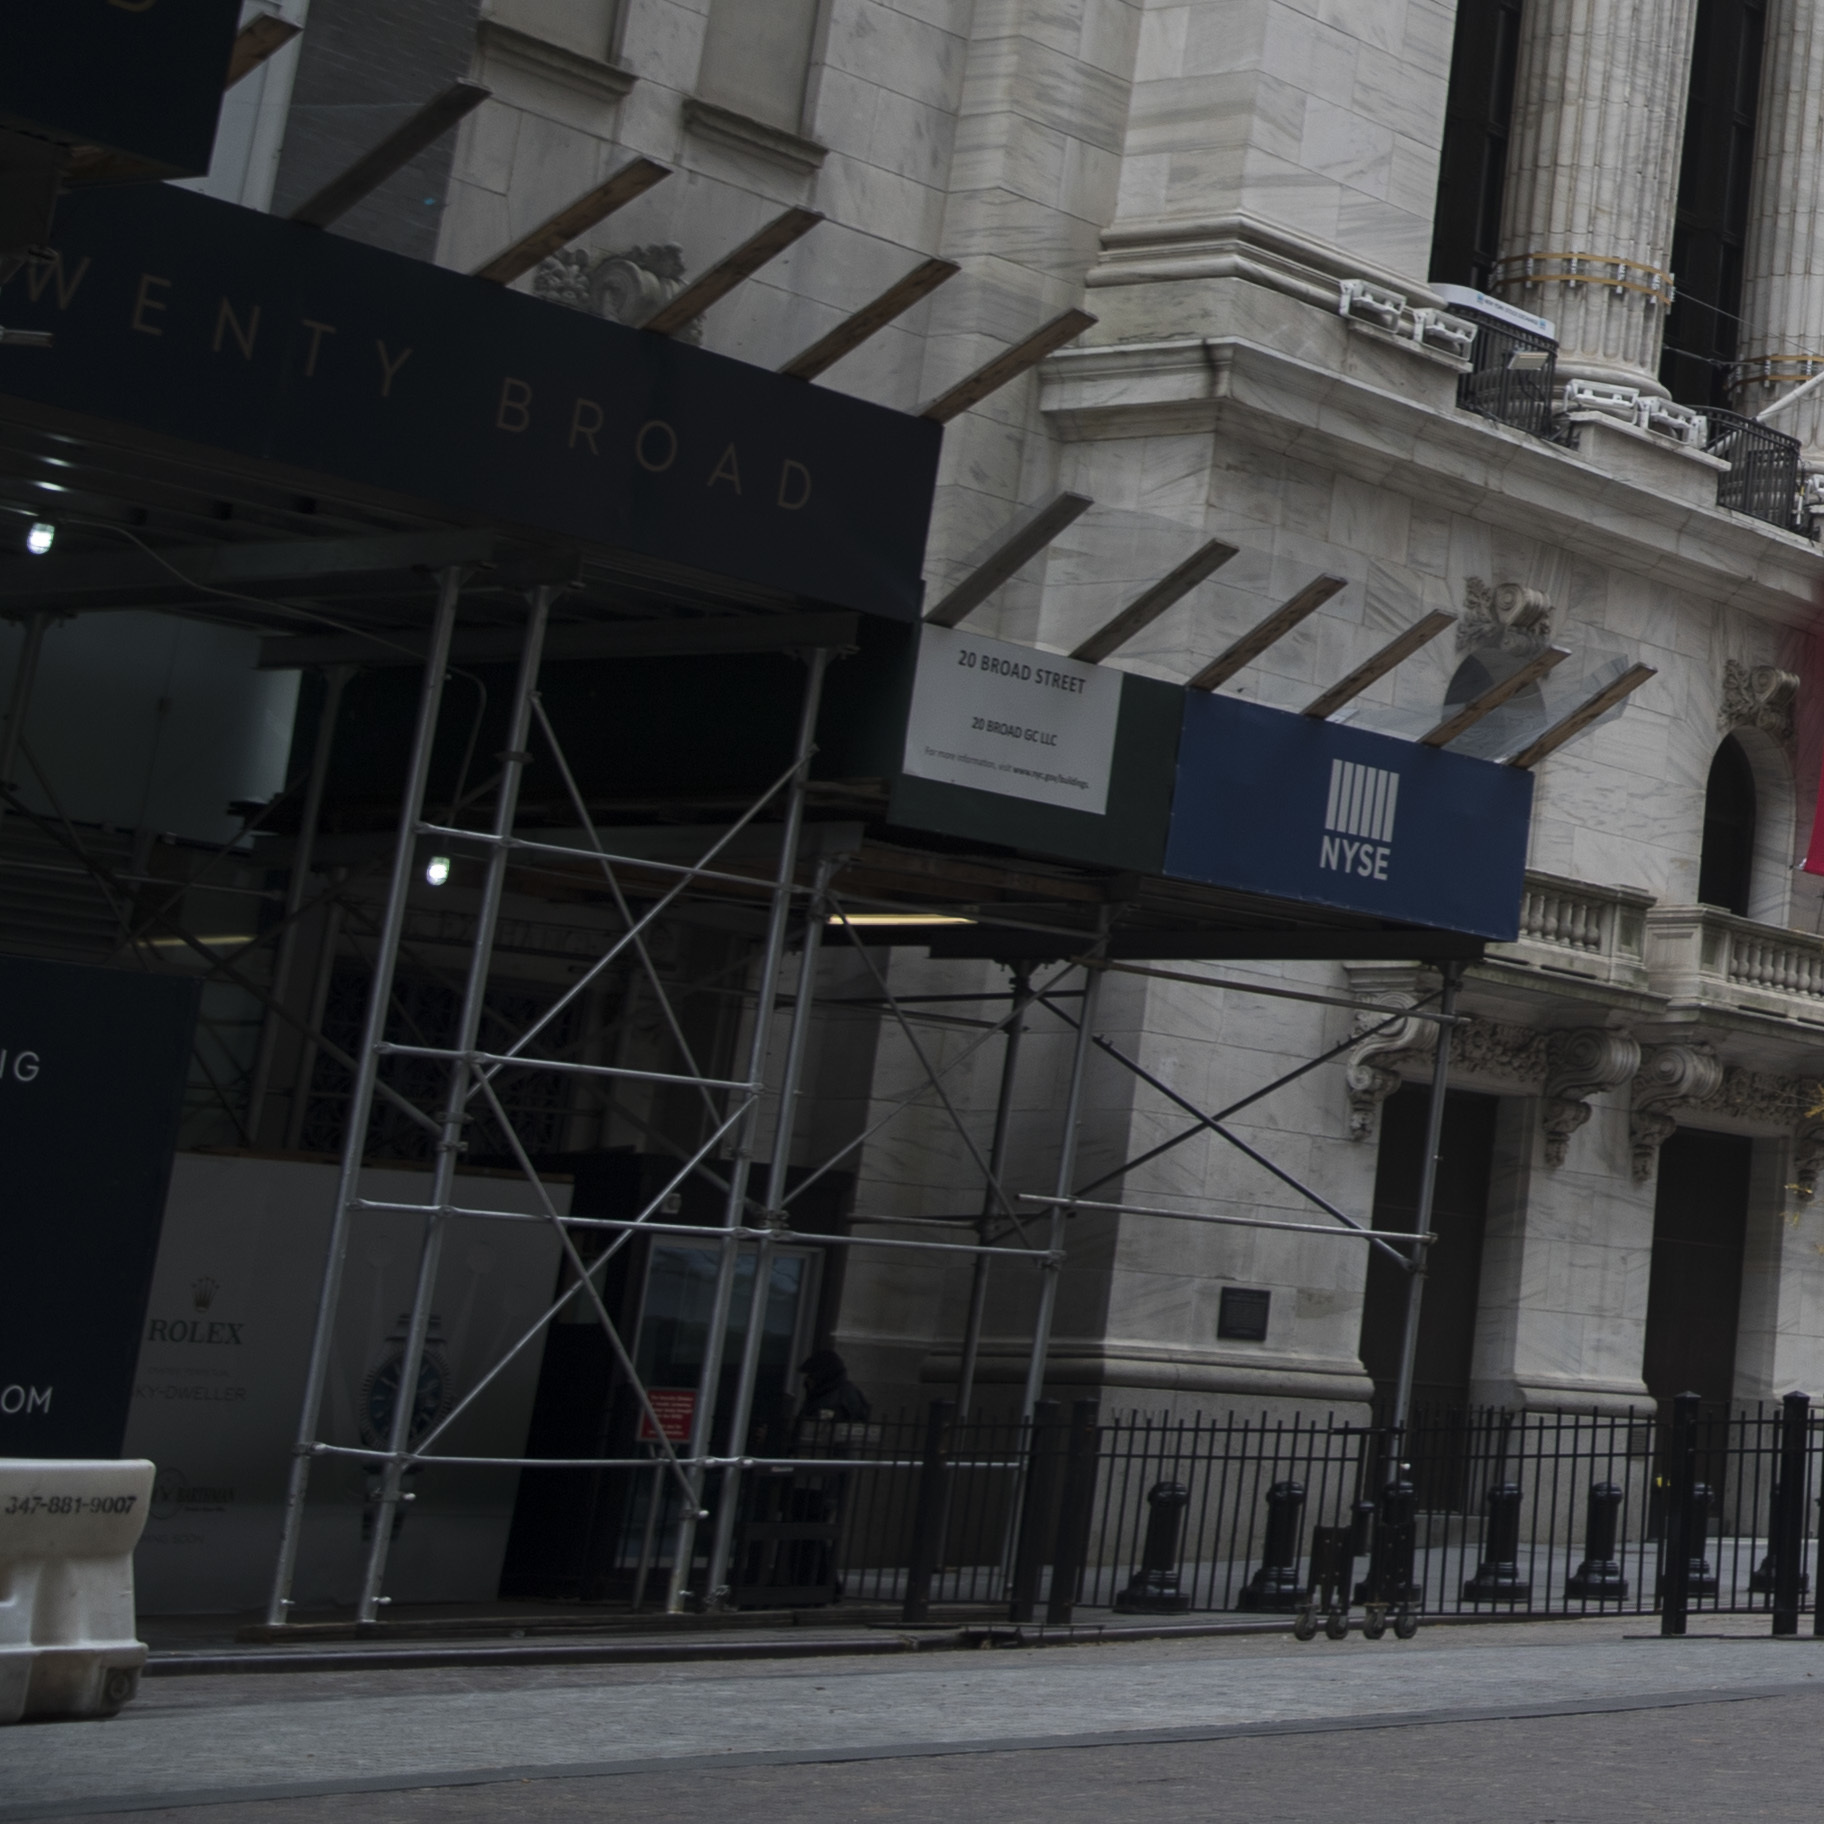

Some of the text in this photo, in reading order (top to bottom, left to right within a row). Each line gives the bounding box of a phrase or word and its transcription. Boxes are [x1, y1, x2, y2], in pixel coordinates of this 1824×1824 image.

[496, 376, 814, 511] BROAD
[958, 649, 1087, 694] 20 BROAD STREET
[971, 716, 1058, 746] 20 BROAD GC LLC
[1319, 834, 1392, 881] NYSE
[148, 1319, 245, 1345] ROLEX
[134, 1384, 248, 1402] KY-DWELLER
[5, 1495, 137, 1514] 347-881-9007
